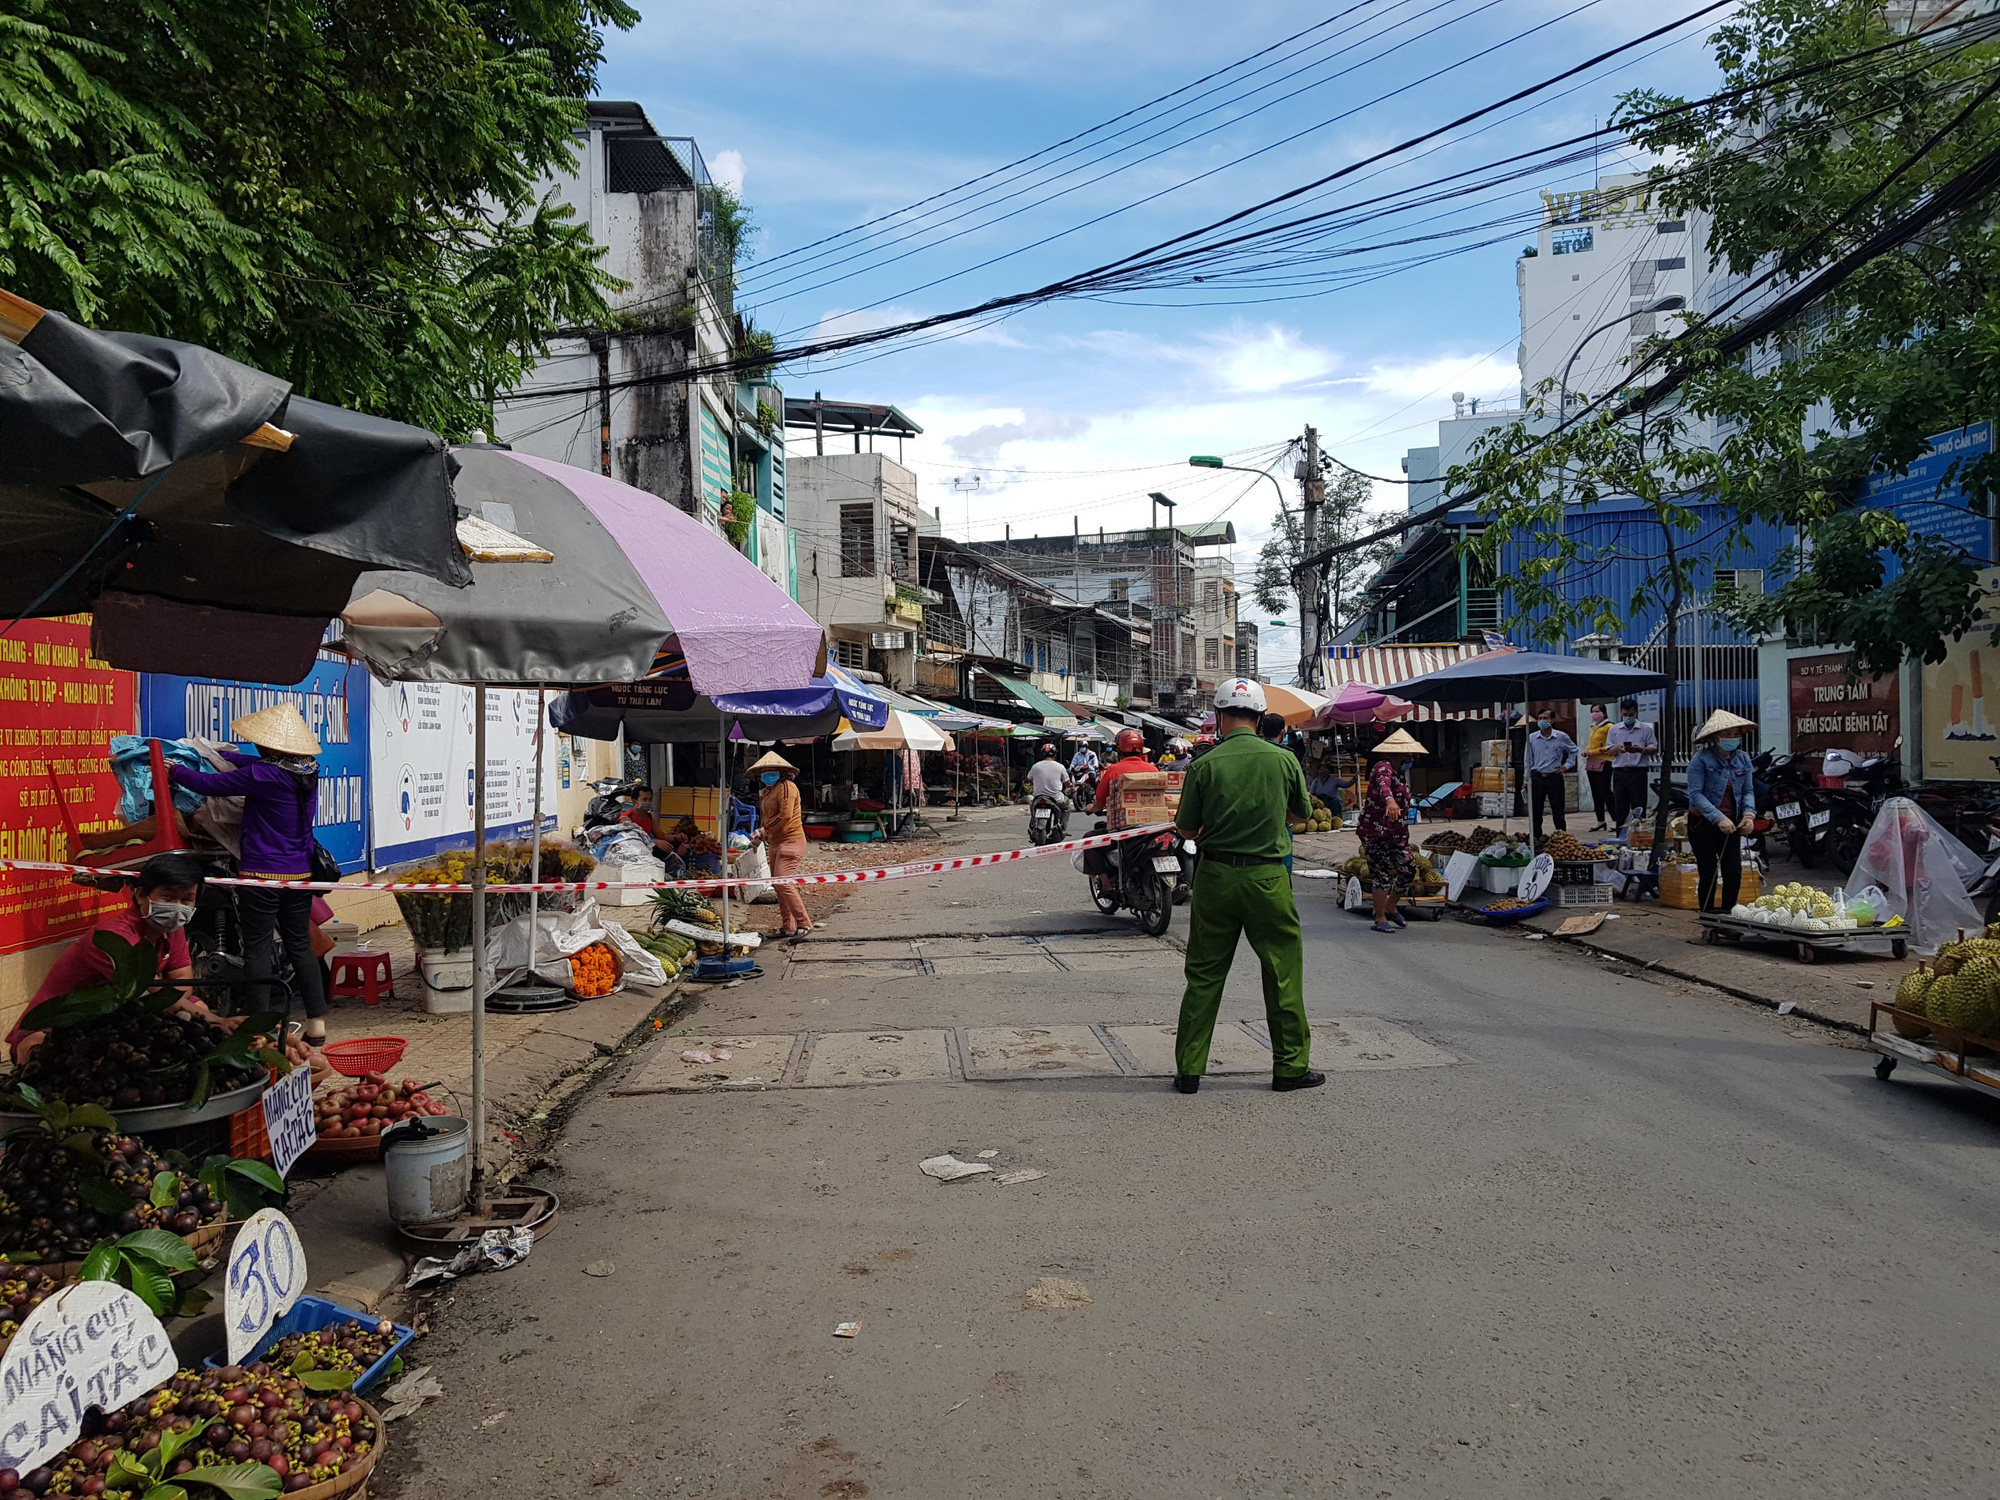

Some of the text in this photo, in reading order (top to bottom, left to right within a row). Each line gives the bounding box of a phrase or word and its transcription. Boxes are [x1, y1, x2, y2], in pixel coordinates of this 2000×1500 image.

[29, 679, 40, 707] TỤ
[41, 675, 57, 708] TẬP
[64, 681, 82, 704] KHAI
[83, 678, 98, 705] BÁO
[1814, 685, 1846, 702] TRUNG
[1819, 710, 1843, 733] SOÁT
[1872, 710, 1889, 736] TẬT
[1520, 882, 1538, 901] 30
[230, 1219, 294, 1332] 30
